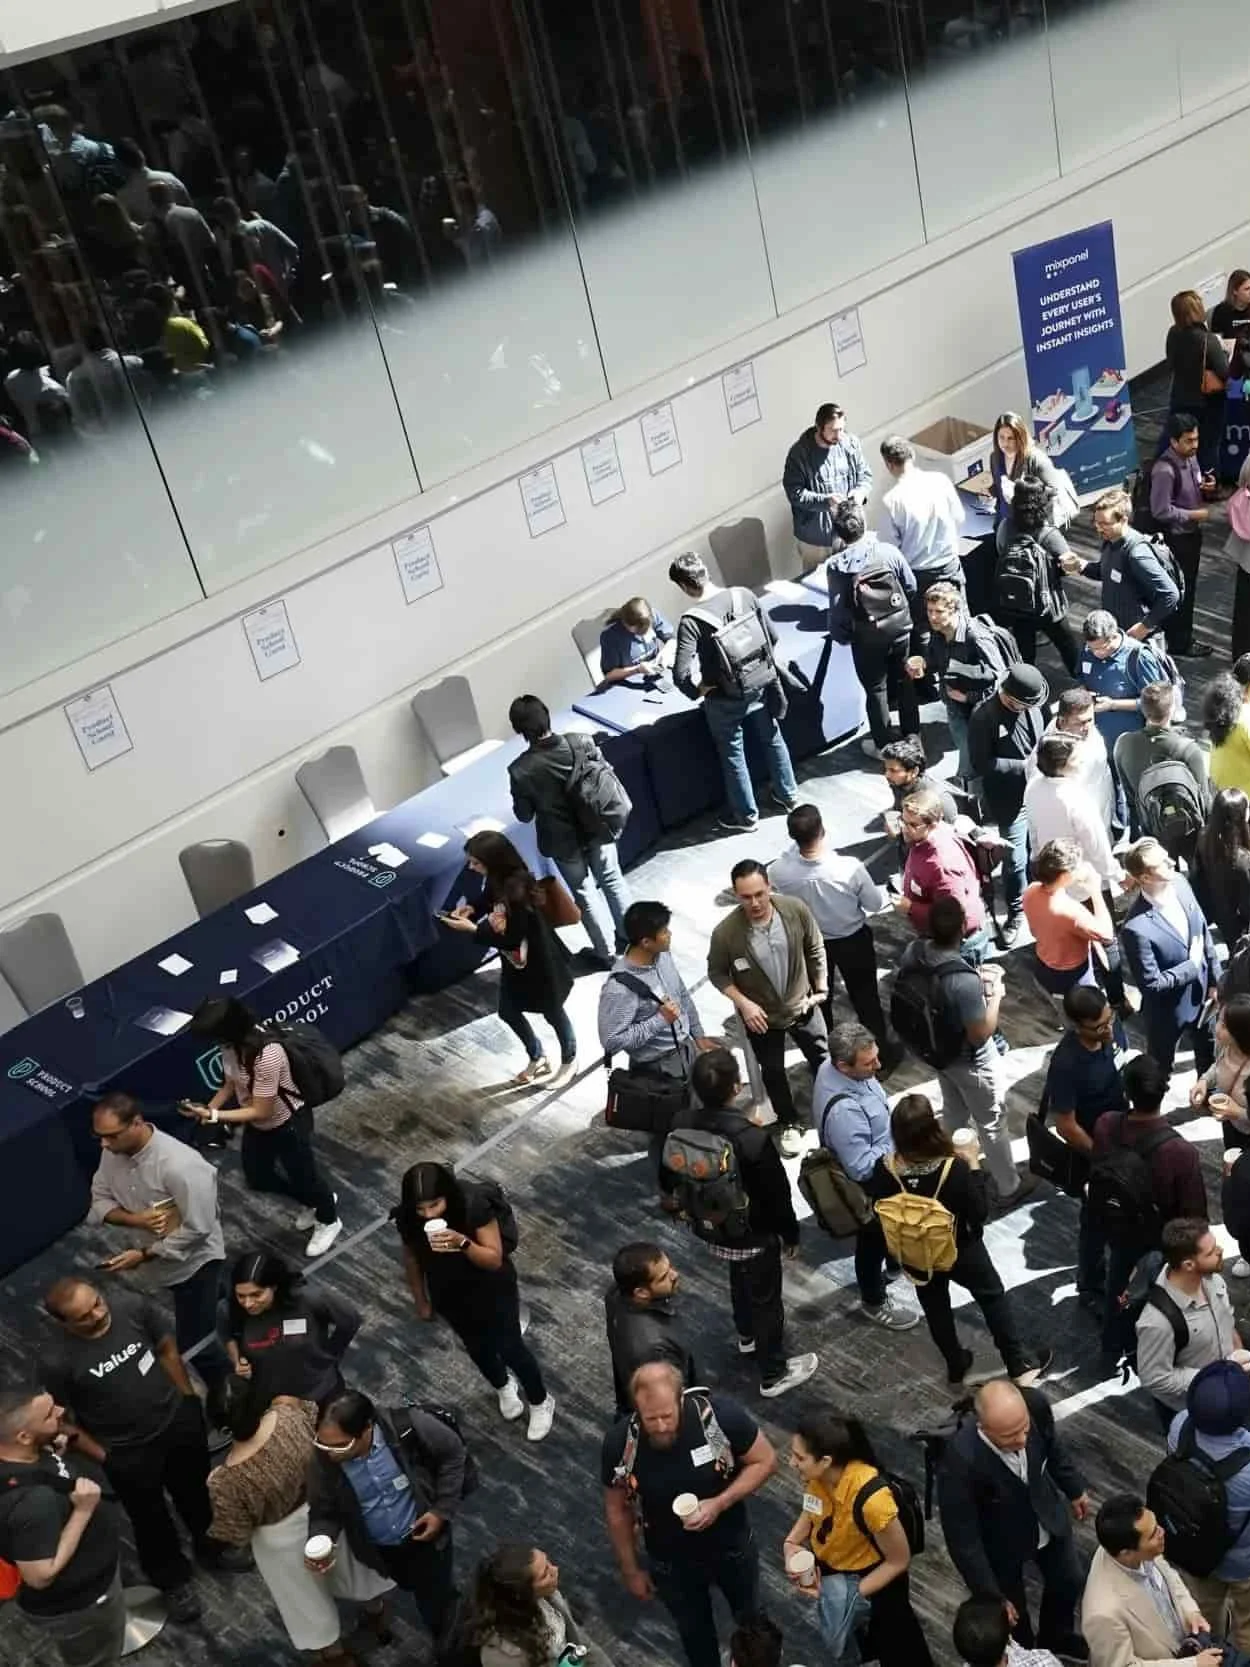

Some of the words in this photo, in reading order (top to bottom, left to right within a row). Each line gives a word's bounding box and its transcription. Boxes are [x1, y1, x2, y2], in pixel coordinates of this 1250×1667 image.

[1045, 248, 1089, 271] mixpanel
[1040, 279, 1100, 306] UNDERSTAND
[1042, 304, 1069, 321] EVERY
[1071, 293, 1102, 310] USER'S
[1036, 333, 1073, 353] INSTANT
[1073, 318, 1114, 340] INSIGHTS
[1041, 315, 1082, 337] JOURNEY
[1083, 306, 1106, 321] WITH
[37, 1070, 73, 1094] PRODUCT
[88, 1342, 142, 1378] Value.
